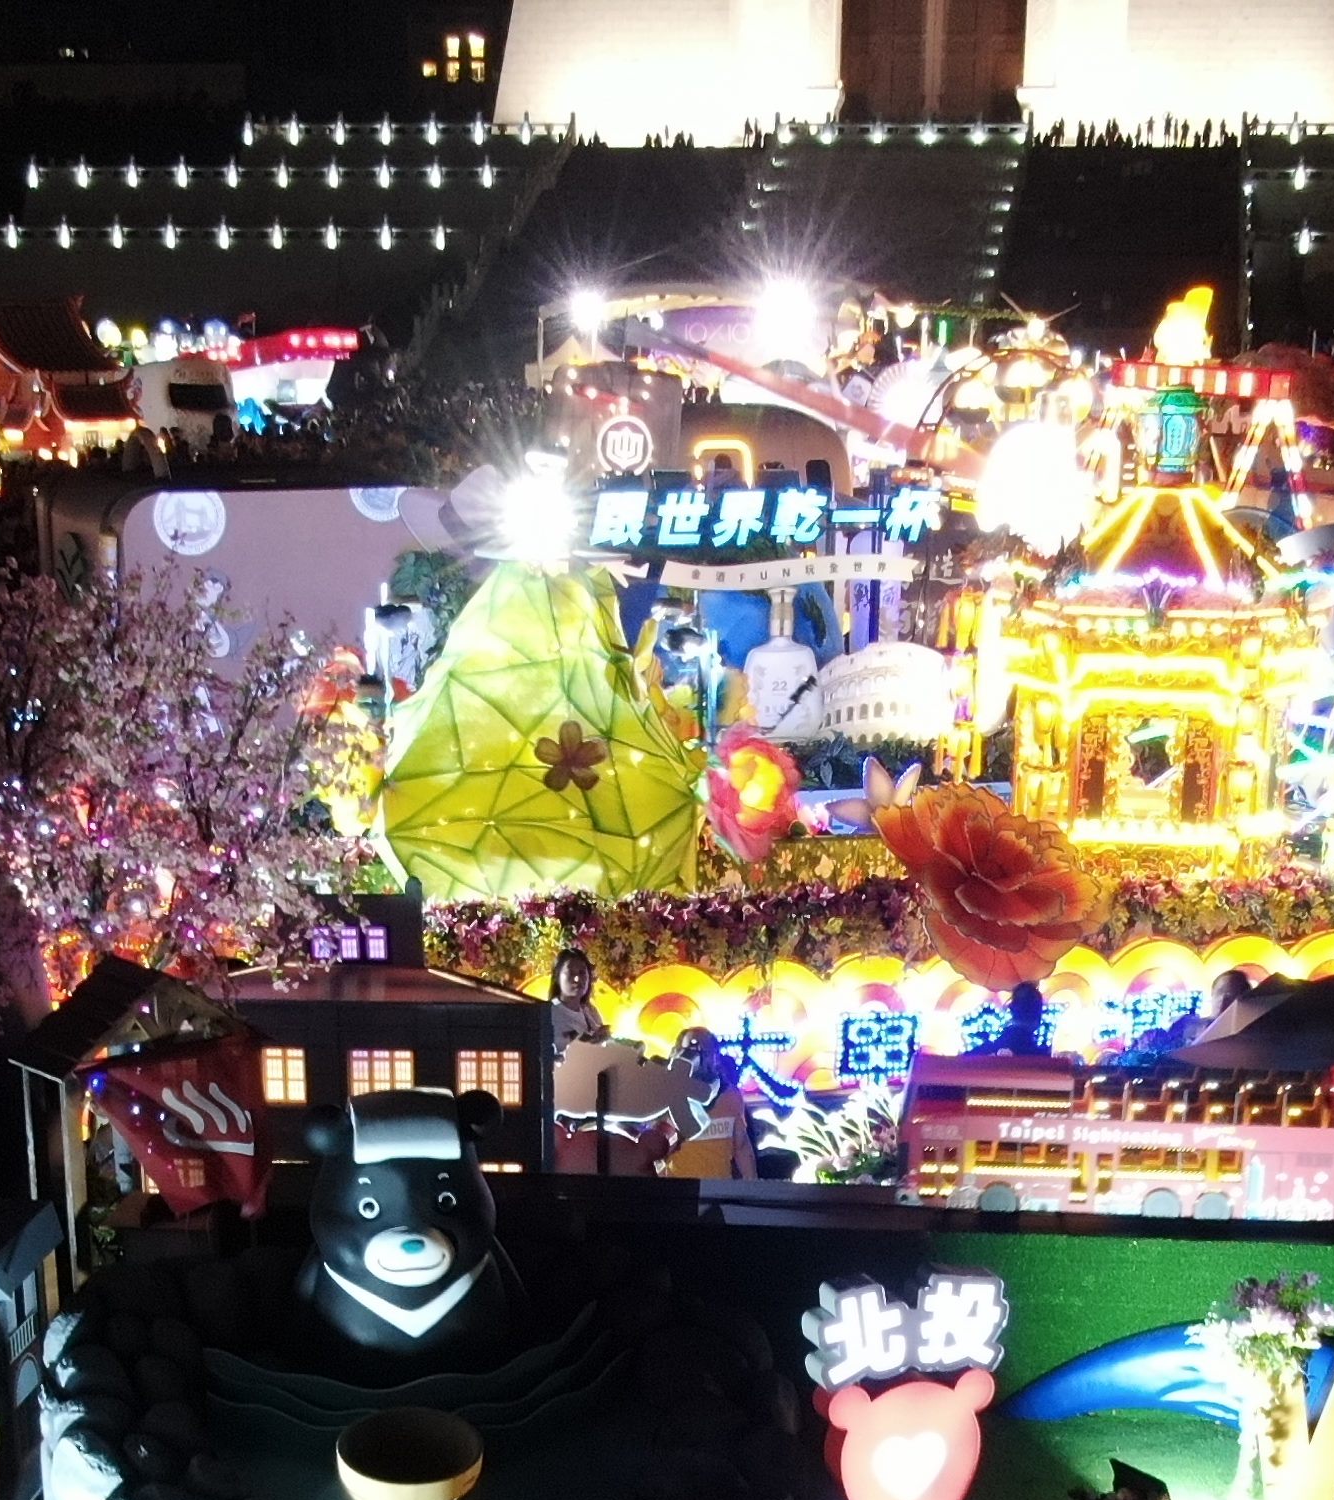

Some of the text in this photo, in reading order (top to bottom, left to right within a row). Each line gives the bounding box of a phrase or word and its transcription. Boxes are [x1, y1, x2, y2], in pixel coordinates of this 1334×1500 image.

[589, 486, 943, 547] 跟世界乾一杯
[998, 1119, 1066, 1143] Taipei
[823, 1282, 1001, 1386] 北投
